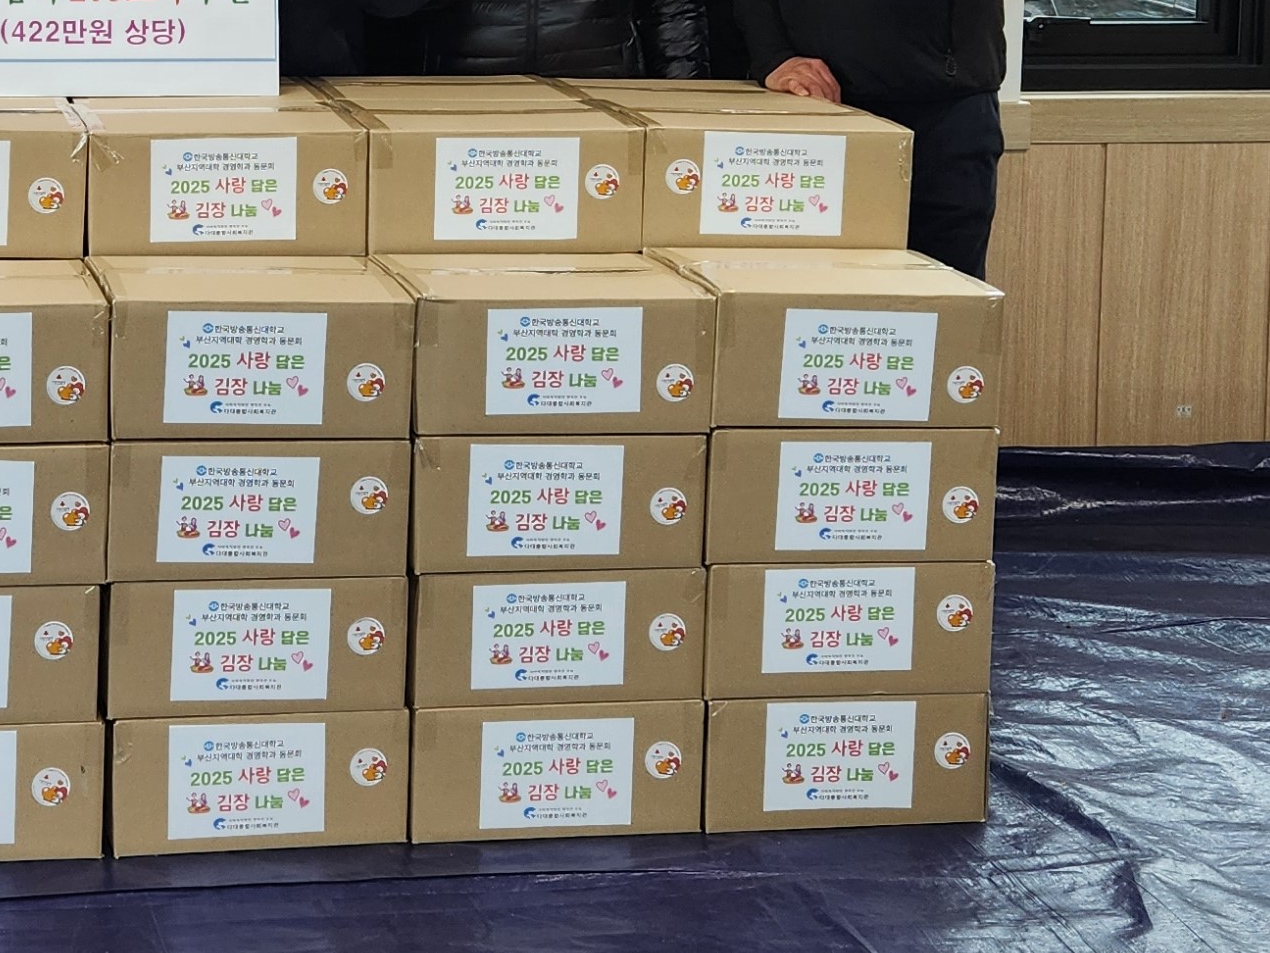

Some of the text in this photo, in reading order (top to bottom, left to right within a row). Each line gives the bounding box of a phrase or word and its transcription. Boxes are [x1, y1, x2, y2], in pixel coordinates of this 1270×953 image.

[0, 18, 186, 45] (422만원 상당)
[454, 172, 560, 190] 2025 사랑 담은
[721, 171, 826, 189] 2025 사랑 담은
[478, 197, 540, 214] 김장 나눔
[744, 195, 805, 212] 김장 나눔
[187, 351, 305, 370] 2025 사랑 담은
[213, 377, 282, 396] 김장 나눔
[489, 486, 603, 505] 2025 사랑 담은
[514, 512, 580, 531] 김장 나눔
[193, 627, 310, 646] 2025 사랑 담은
[219, 653, 287, 672] 김장 나눔
[785, 739, 895, 757] 2025 사랑 담은
[810, 764, 874, 783] 김장 나눔
